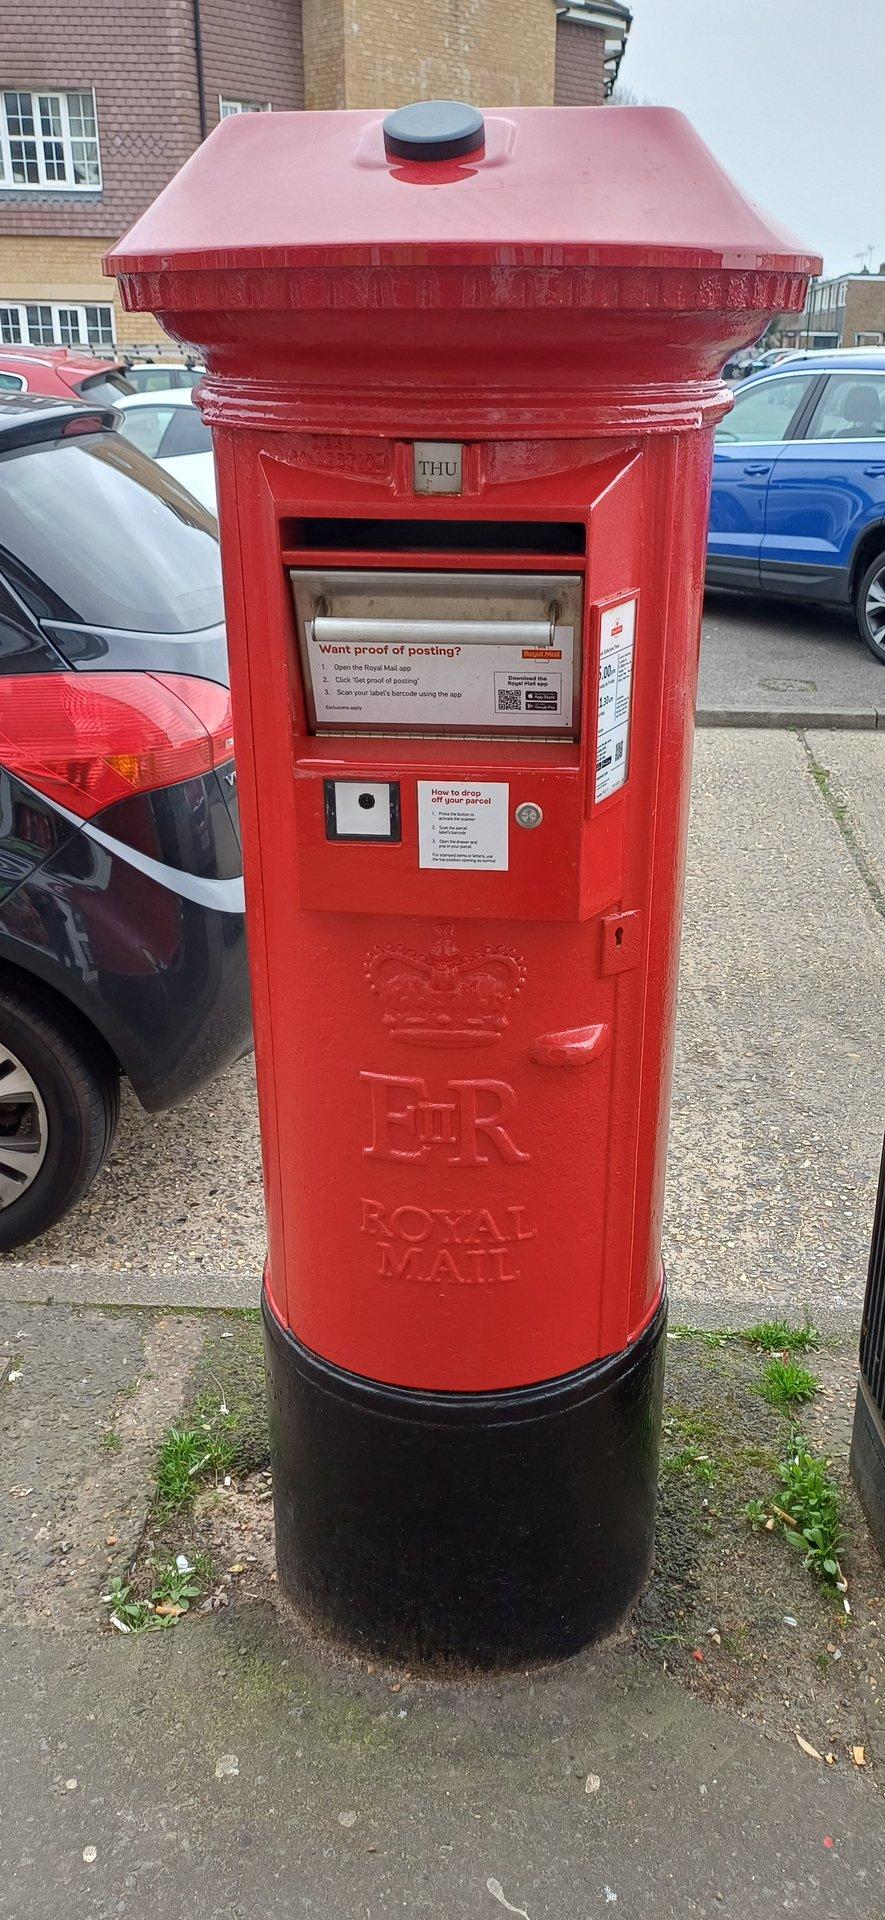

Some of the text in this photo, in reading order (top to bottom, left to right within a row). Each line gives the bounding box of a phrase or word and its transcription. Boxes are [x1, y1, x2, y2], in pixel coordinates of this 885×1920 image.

[419, 461, 457, 476] THU
[319, 644, 462, 658] Want proof of posting?
[524, 650, 543, 658] Royal
[334, 664, 352, 672] Open
[461, 790, 481, 798] drop
[358, 1197, 538, 1245] ROYAL
[376, 1242, 521, 1284] MAIL
